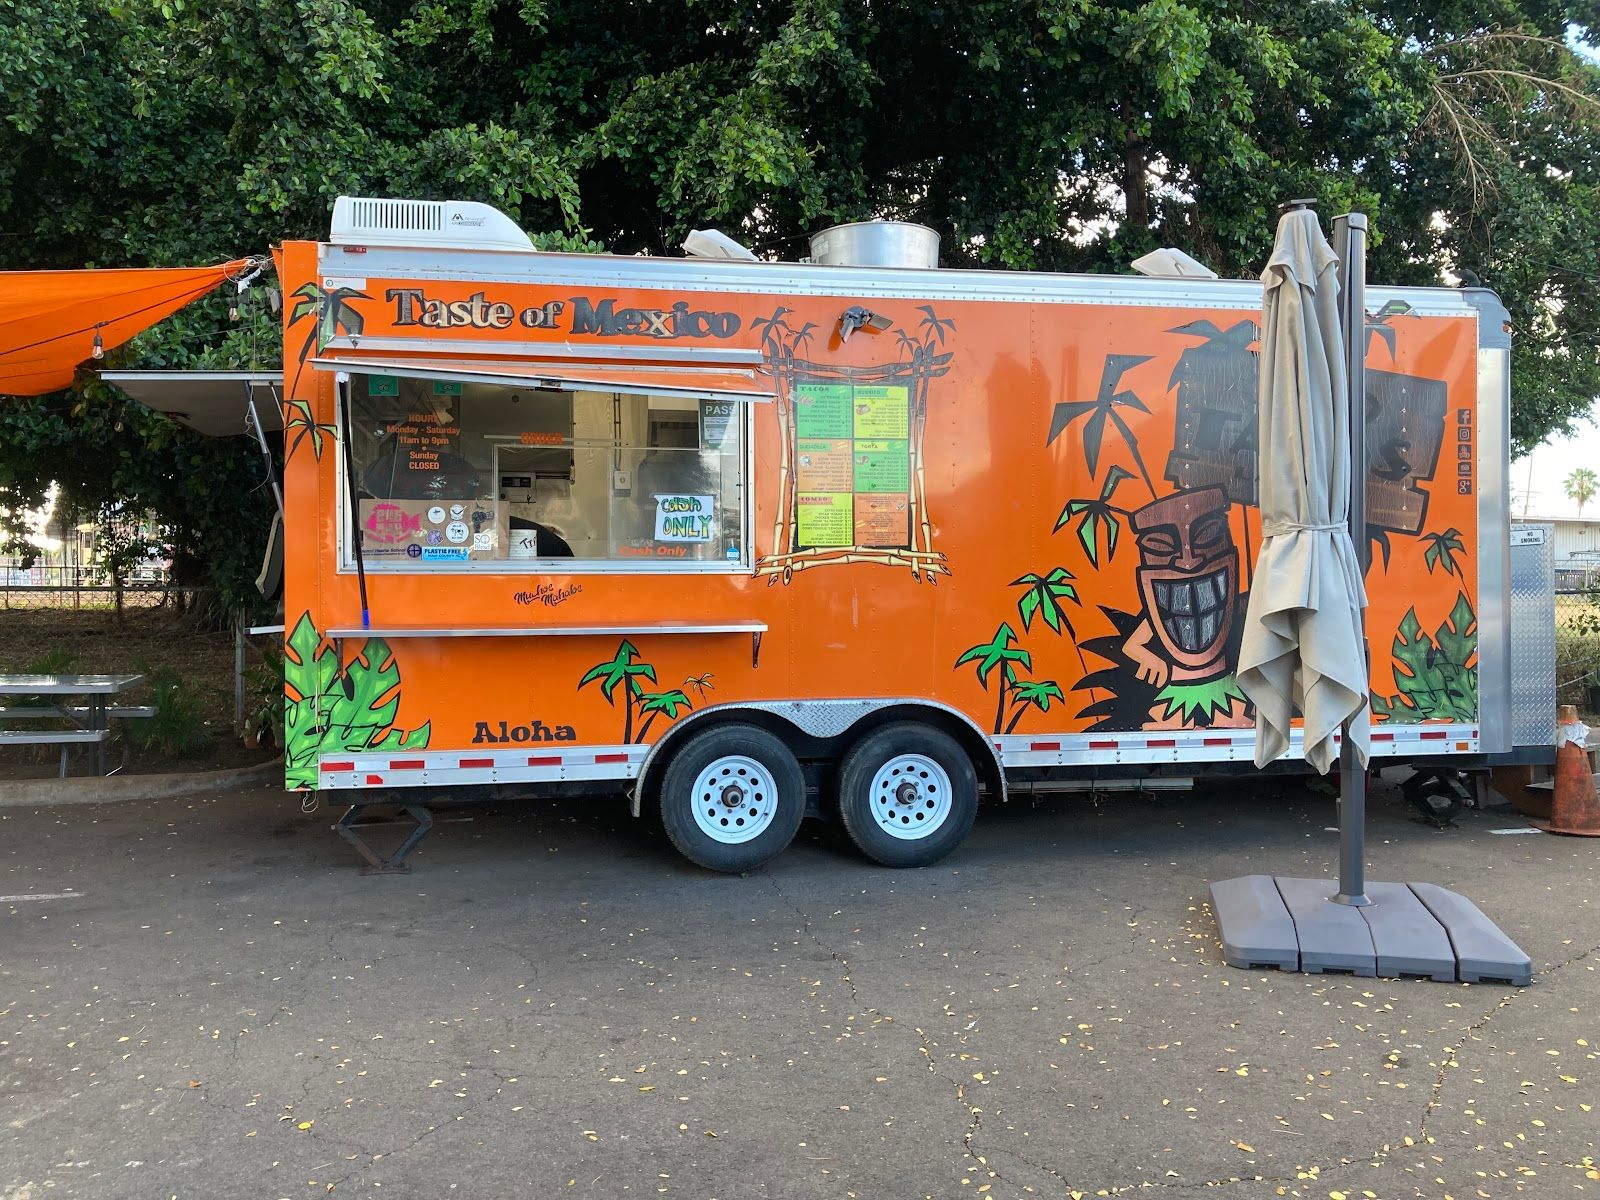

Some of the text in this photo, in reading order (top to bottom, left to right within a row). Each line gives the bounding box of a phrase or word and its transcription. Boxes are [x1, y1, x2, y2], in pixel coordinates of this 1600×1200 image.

[386, 288, 742, 339] Taste of Mexico
[705, 405, 736, 415] PASS
[386, 425, 418, 435] Monday
[427, 426, 461, 436] Saturday
[400, 437, 419, 445] 11am
[432, 437, 450, 446] 9pm
[409, 451, 439, 461] Sunday
[408, 462, 440, 471] CLOSED
[662, 515, 713, 540] ONLY
[619, 545, 687, 557] Cash Only
[472, 720, 577, 744] Aloha
